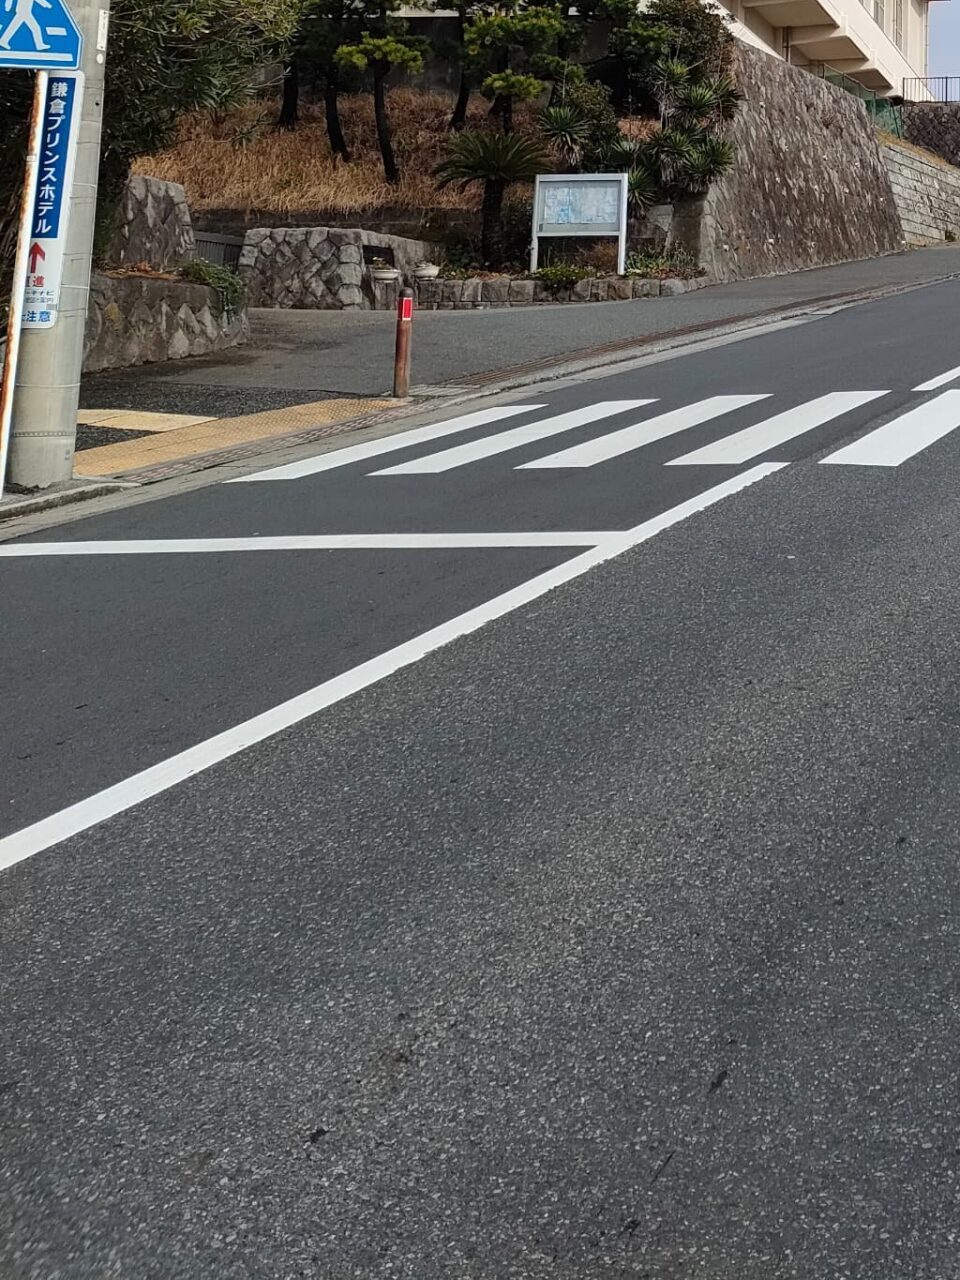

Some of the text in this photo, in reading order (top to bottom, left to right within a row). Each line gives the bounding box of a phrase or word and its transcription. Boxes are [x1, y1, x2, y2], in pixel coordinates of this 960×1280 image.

[35, 82, 69, 234] 鎌倉プリンスホテル
